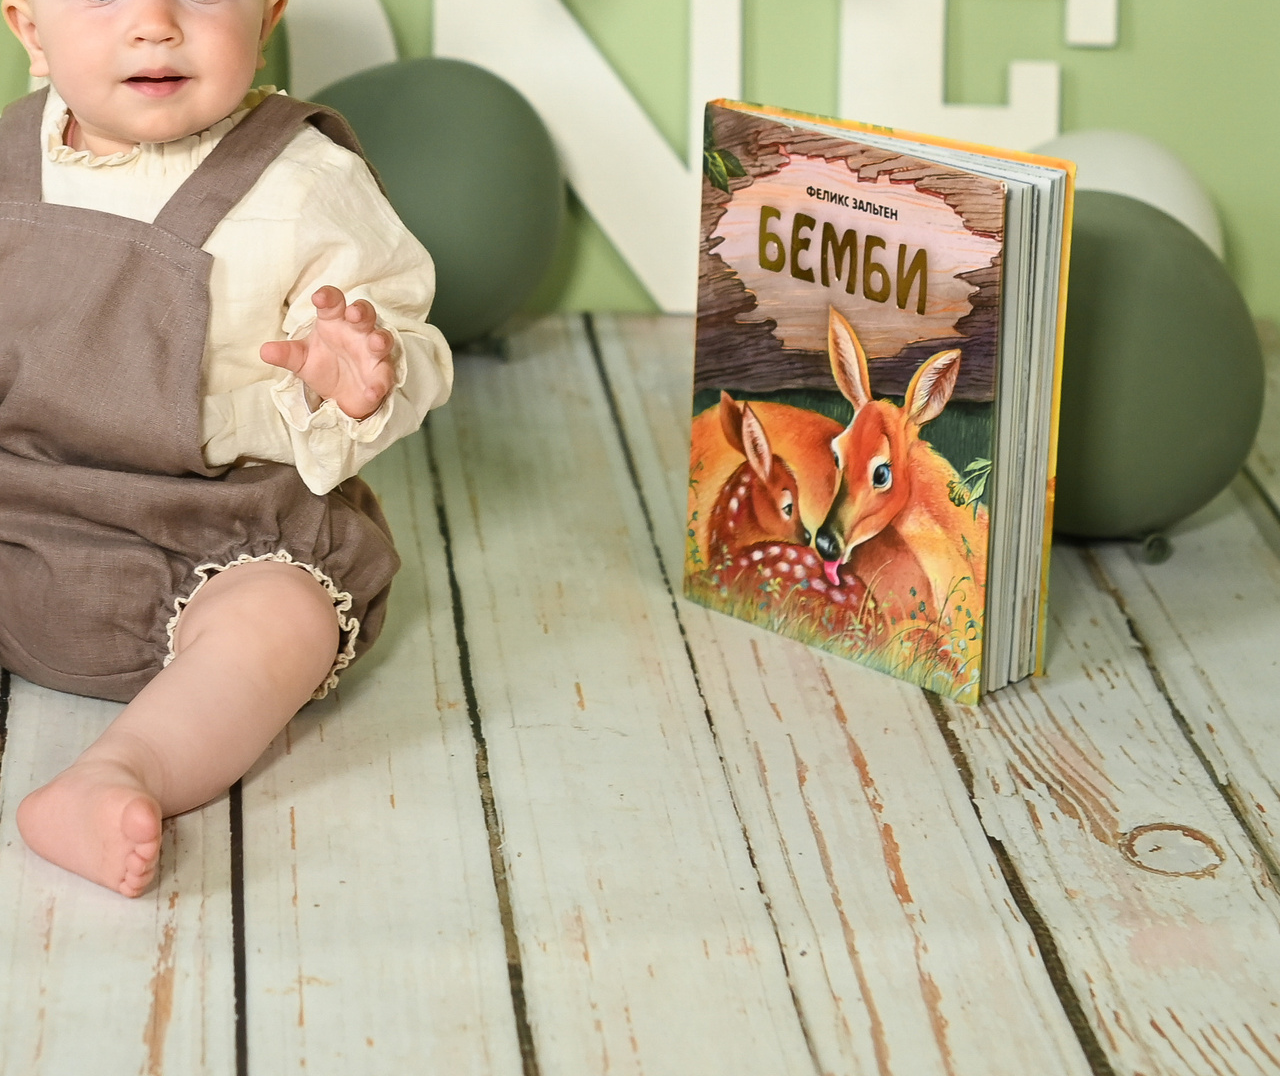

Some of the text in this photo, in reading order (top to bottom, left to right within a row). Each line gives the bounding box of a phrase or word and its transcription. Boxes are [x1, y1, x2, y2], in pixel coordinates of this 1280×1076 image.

[806, 185, 899, 221] ФЕЛИКС ЗАЛЬТЕН
[757, 204, 928, 316] БЕМБИ
